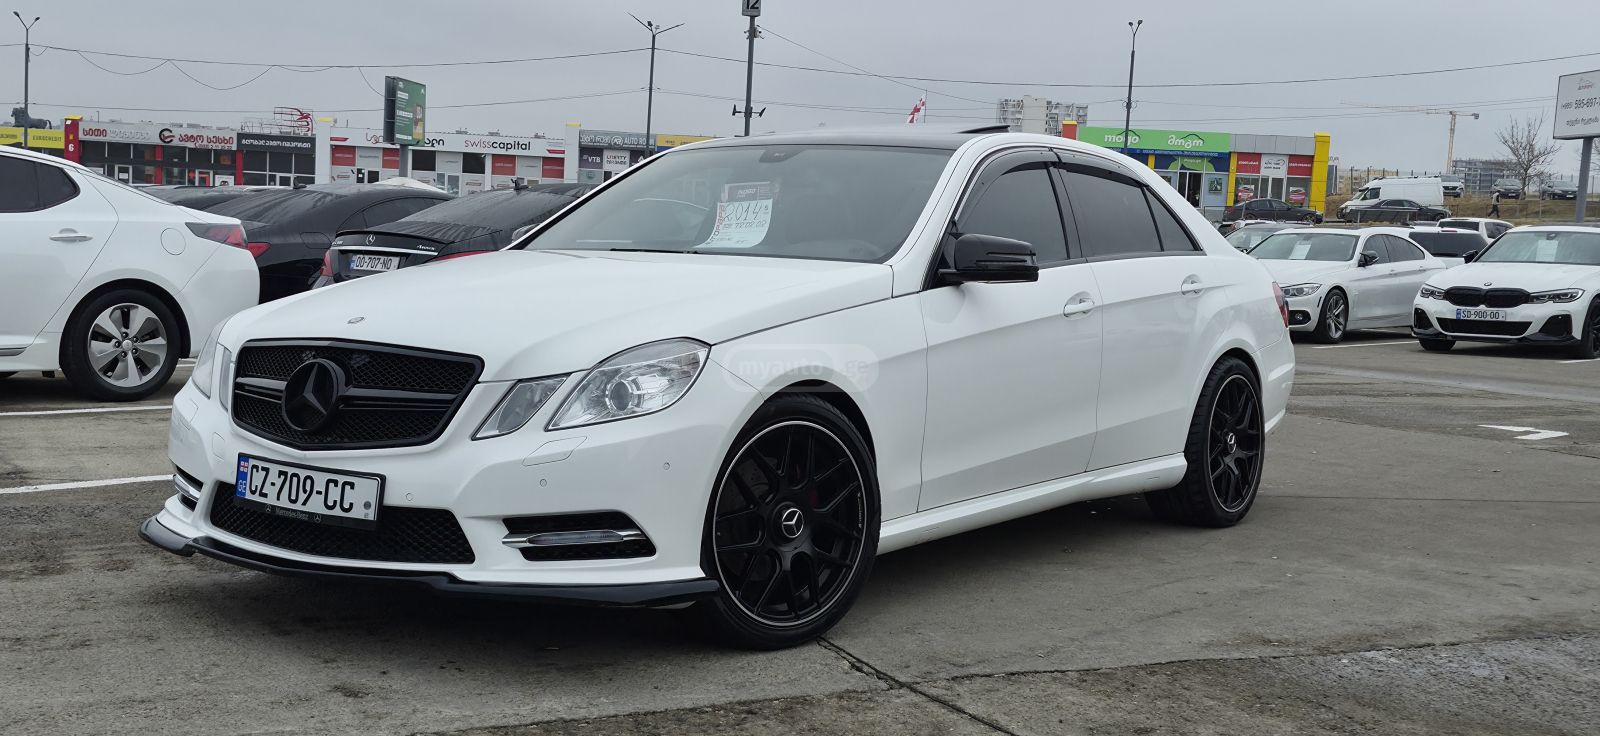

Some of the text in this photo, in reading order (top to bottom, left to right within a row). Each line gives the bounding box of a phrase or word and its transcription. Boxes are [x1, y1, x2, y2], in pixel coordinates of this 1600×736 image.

[68, 143, 74, 151] 6
[1462, 310, 1500, 319] SD-900-00
[248, 463, 356, 513] CZ-709-CC
